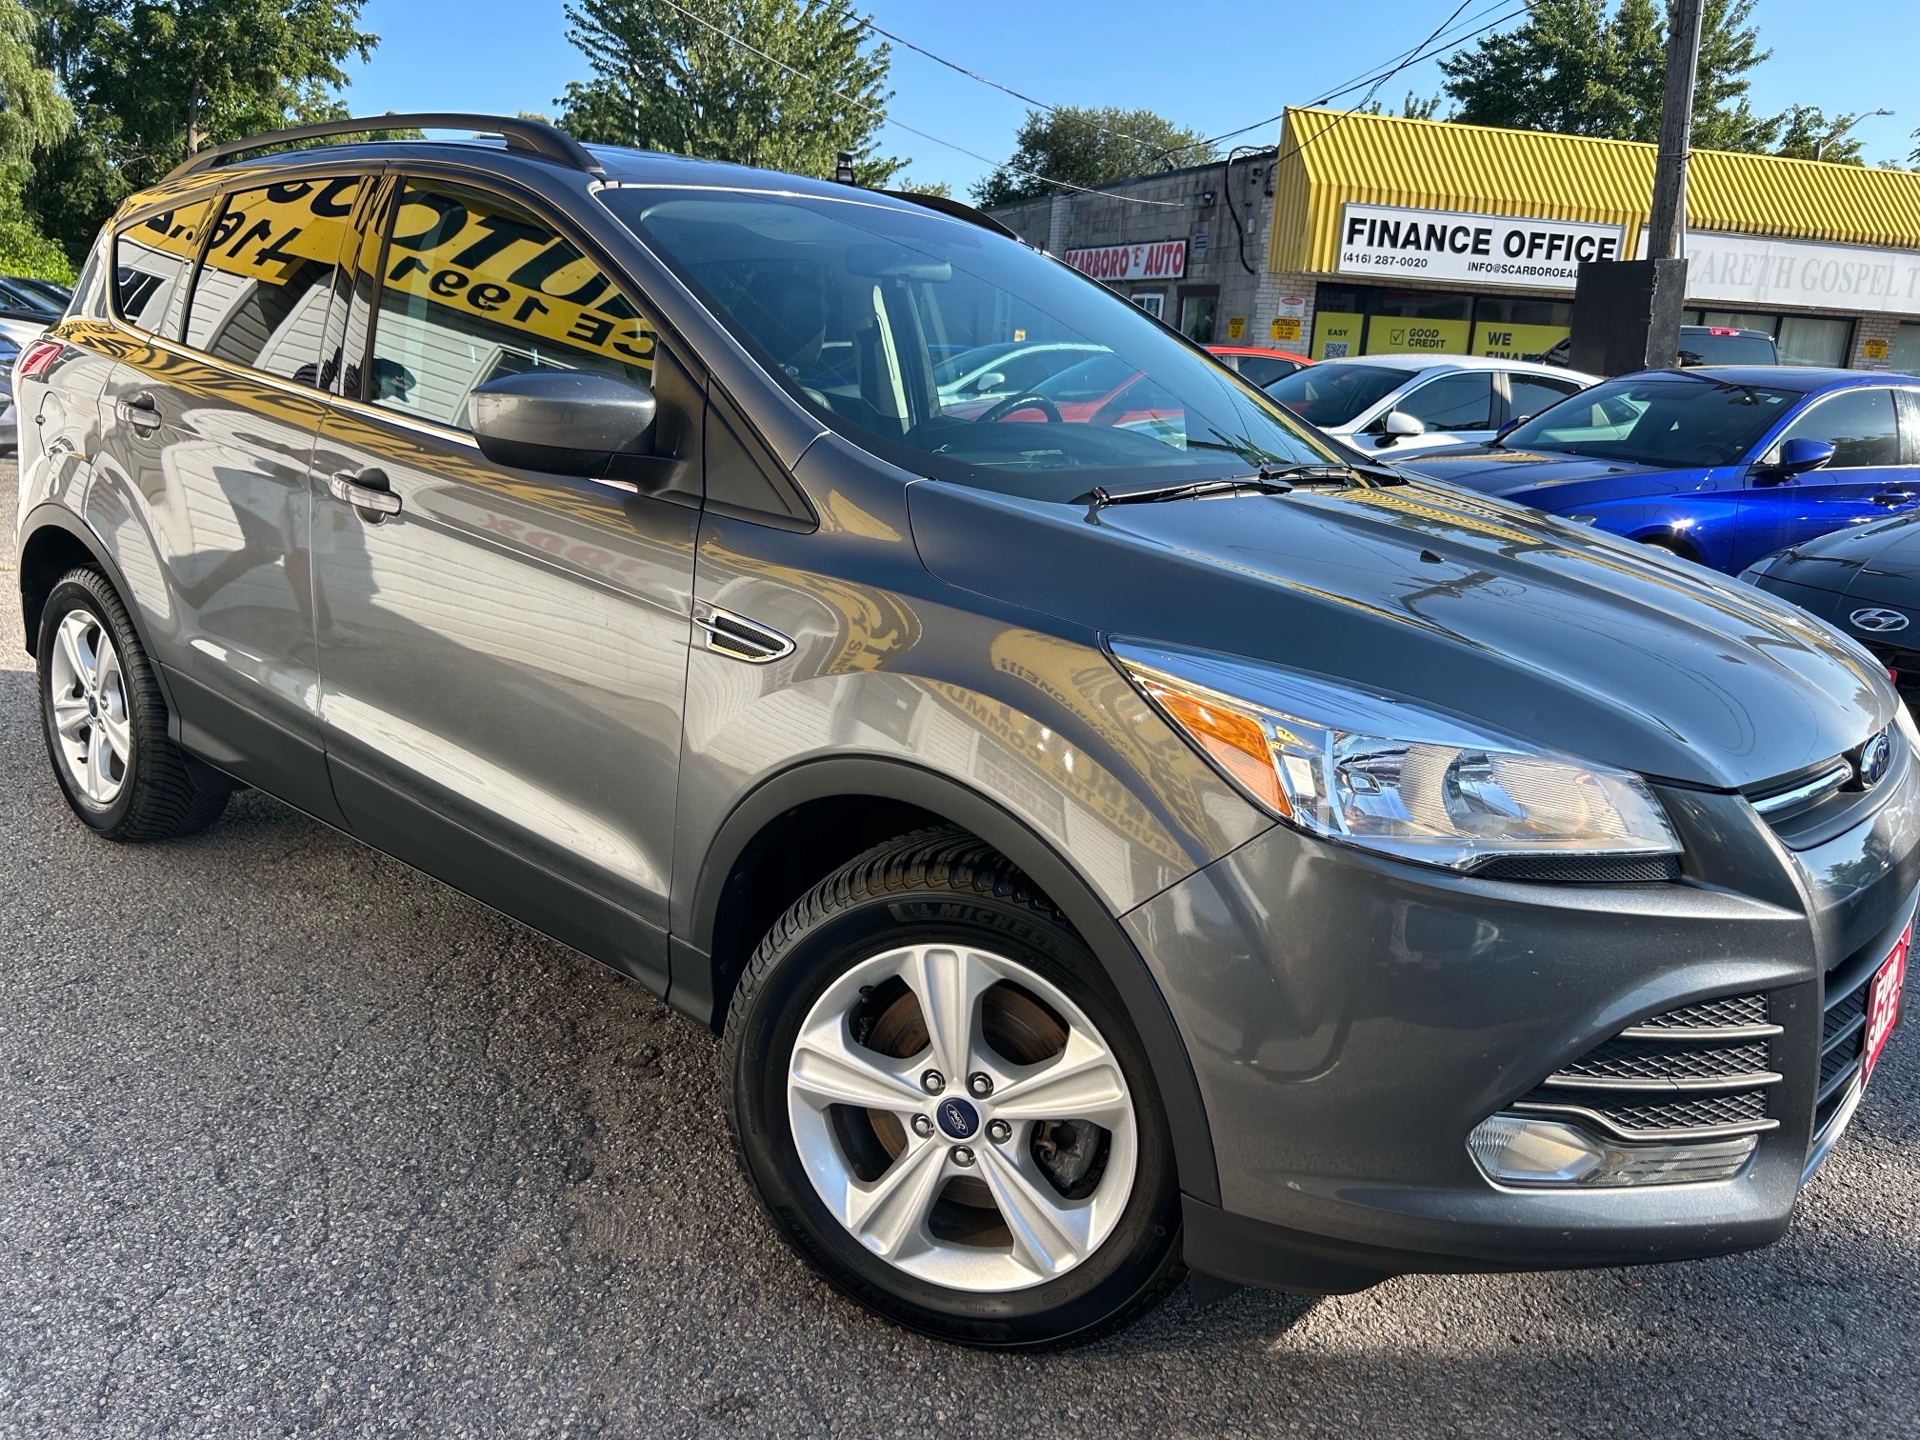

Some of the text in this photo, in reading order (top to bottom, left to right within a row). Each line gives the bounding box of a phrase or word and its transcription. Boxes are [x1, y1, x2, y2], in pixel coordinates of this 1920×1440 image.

[1346, 217, 1617, 262] FINANCE OFFICE
[1143, 242, 1184, 275] AUTO
[1343, 253, 1428, 268] (416) 287-0020
[1467, 261, 1579, 279] INFO@SCARBOROEAU
[1687, 249, 1797, 290] ZARETH
[1800, 258, 1899, 297] GOSPEL
[1327, 328, 1348, 337] EASY
[1409, 328, 1439, 338] GOOD
[1487, 331, 1512, 347] WE
[1408, 338, 1446, 349] CREDIT
[1865, 982, 1898, 1074] SALE
